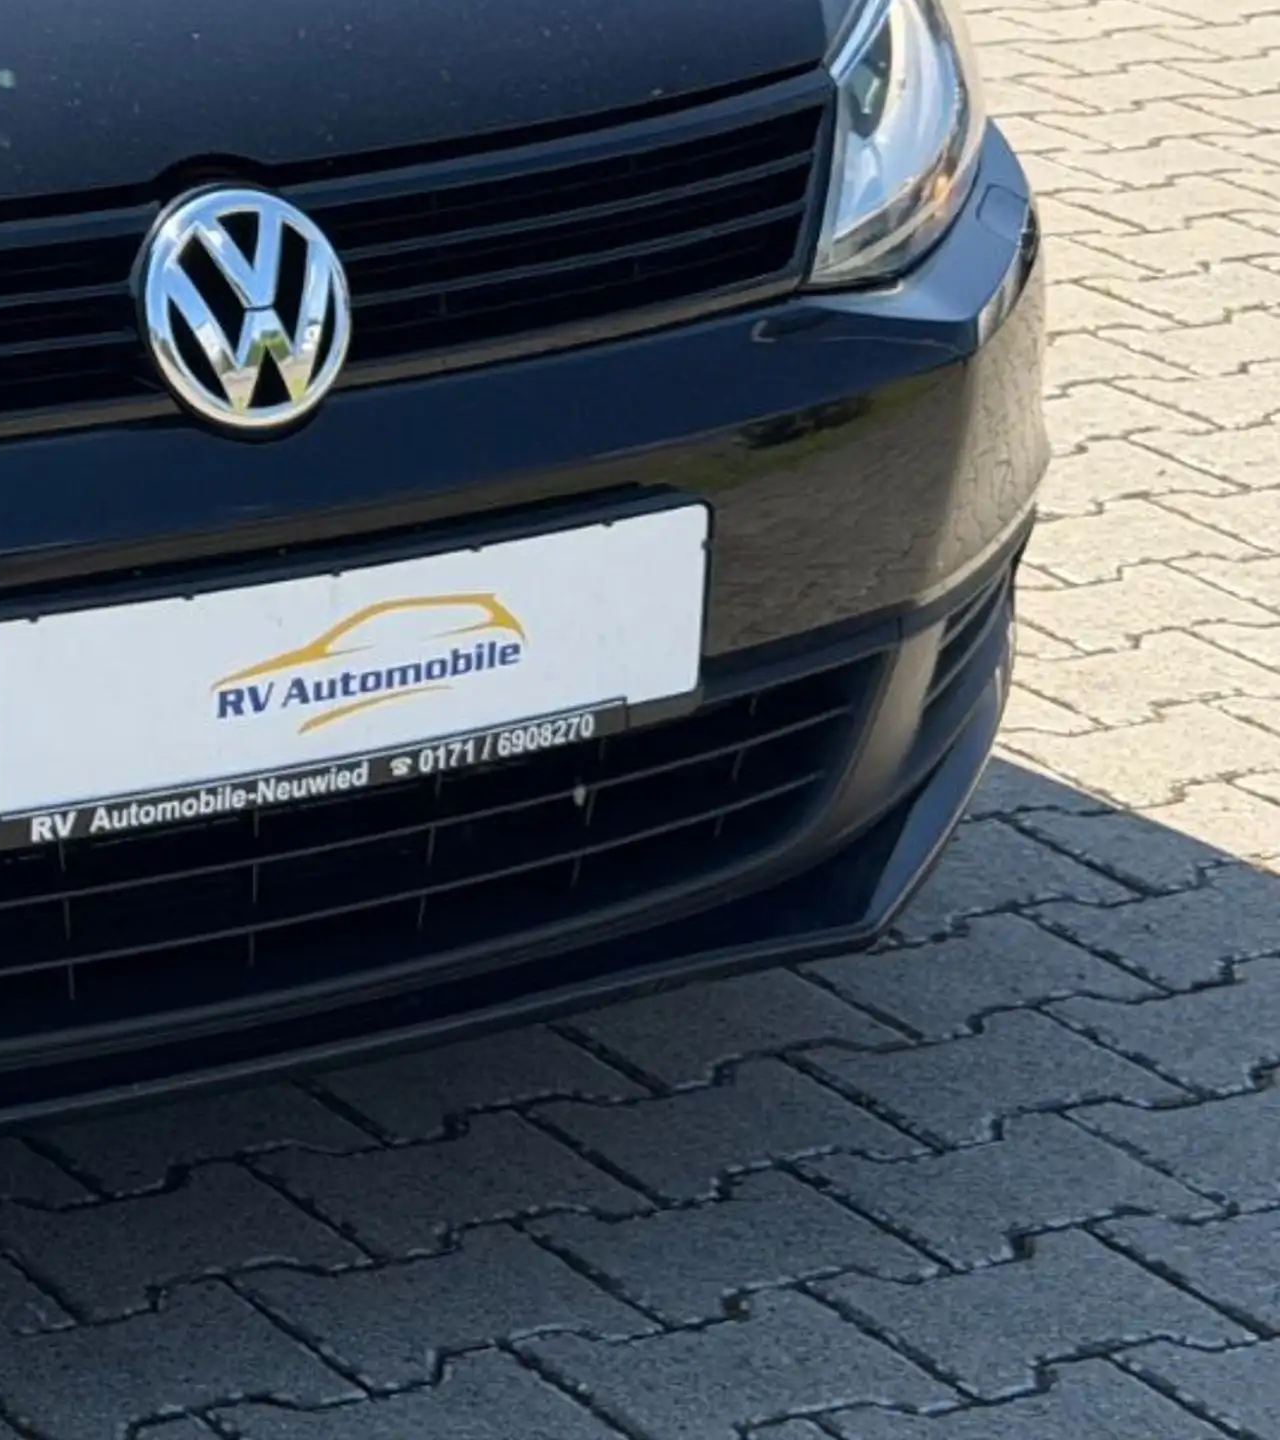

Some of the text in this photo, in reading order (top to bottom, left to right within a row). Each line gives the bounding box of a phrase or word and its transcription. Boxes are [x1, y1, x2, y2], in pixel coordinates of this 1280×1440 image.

[158, 198, 340, 416] VW
[216, 641, 522, 719] RV Automobile
[30, 811, 78, 843] RV
[89, 760, 370, 834] Automobile-Neuwied
[418, 740, 475, 774] 0171
[497, 713, 595, 757] 6908270
